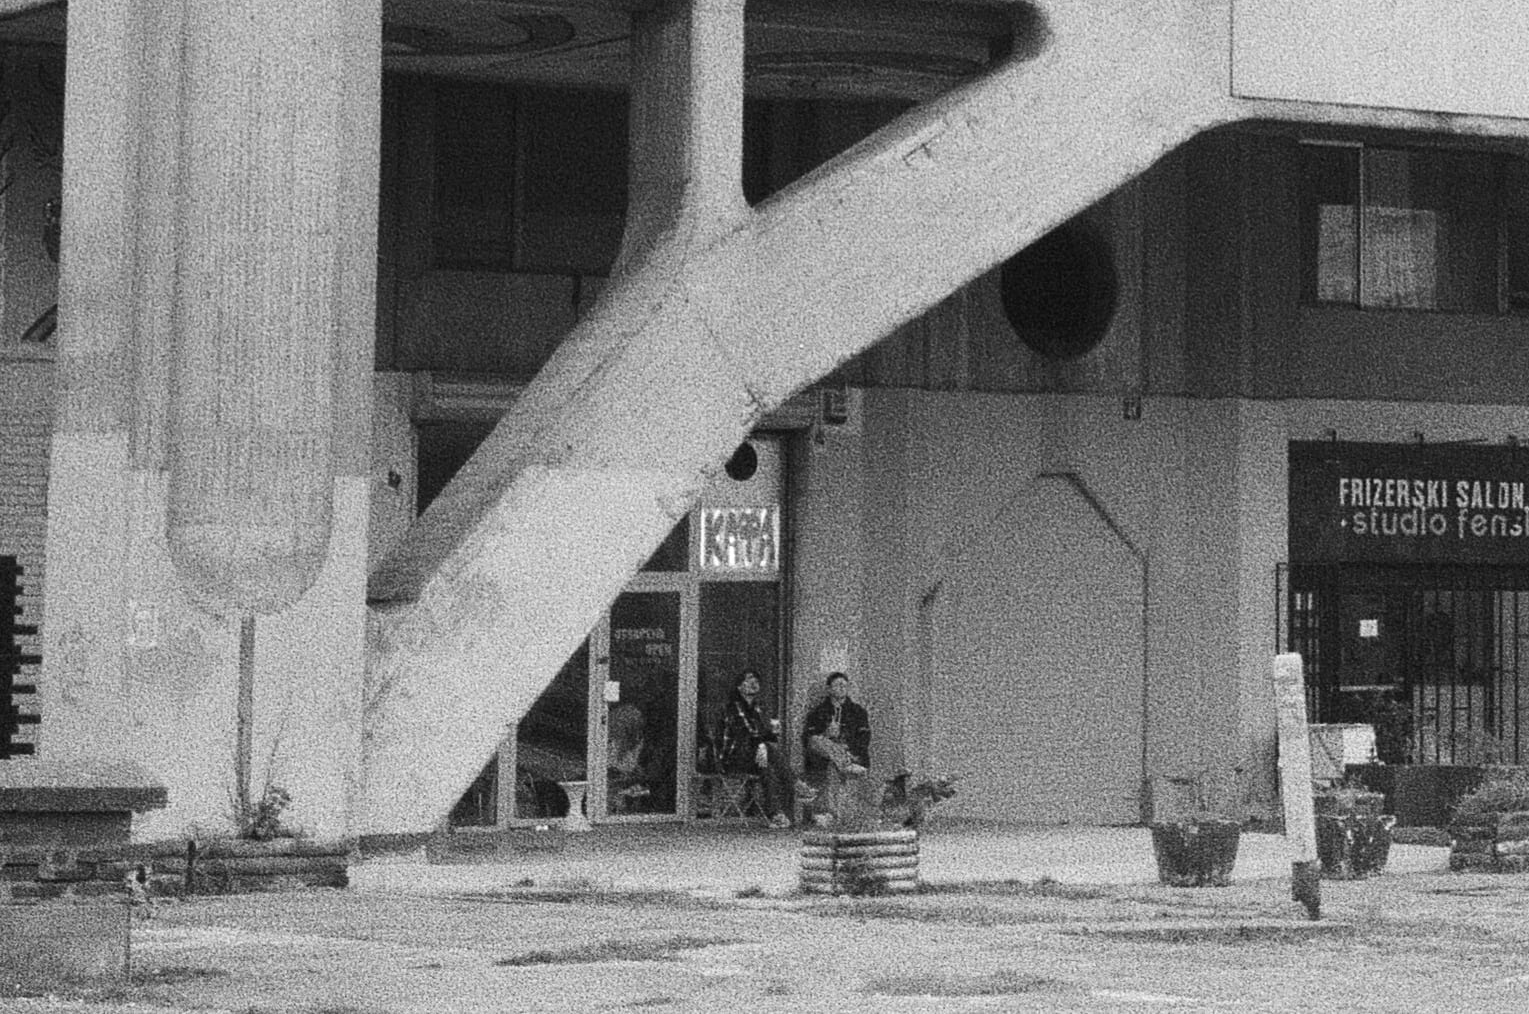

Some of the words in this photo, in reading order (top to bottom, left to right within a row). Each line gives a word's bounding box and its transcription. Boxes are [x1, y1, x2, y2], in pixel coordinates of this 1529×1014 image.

[1338, 477, 1448, 508] FRIZERSKI
[1455, 479, 1525, 510] SALON
[1351, 504, 1448, 536] studio
